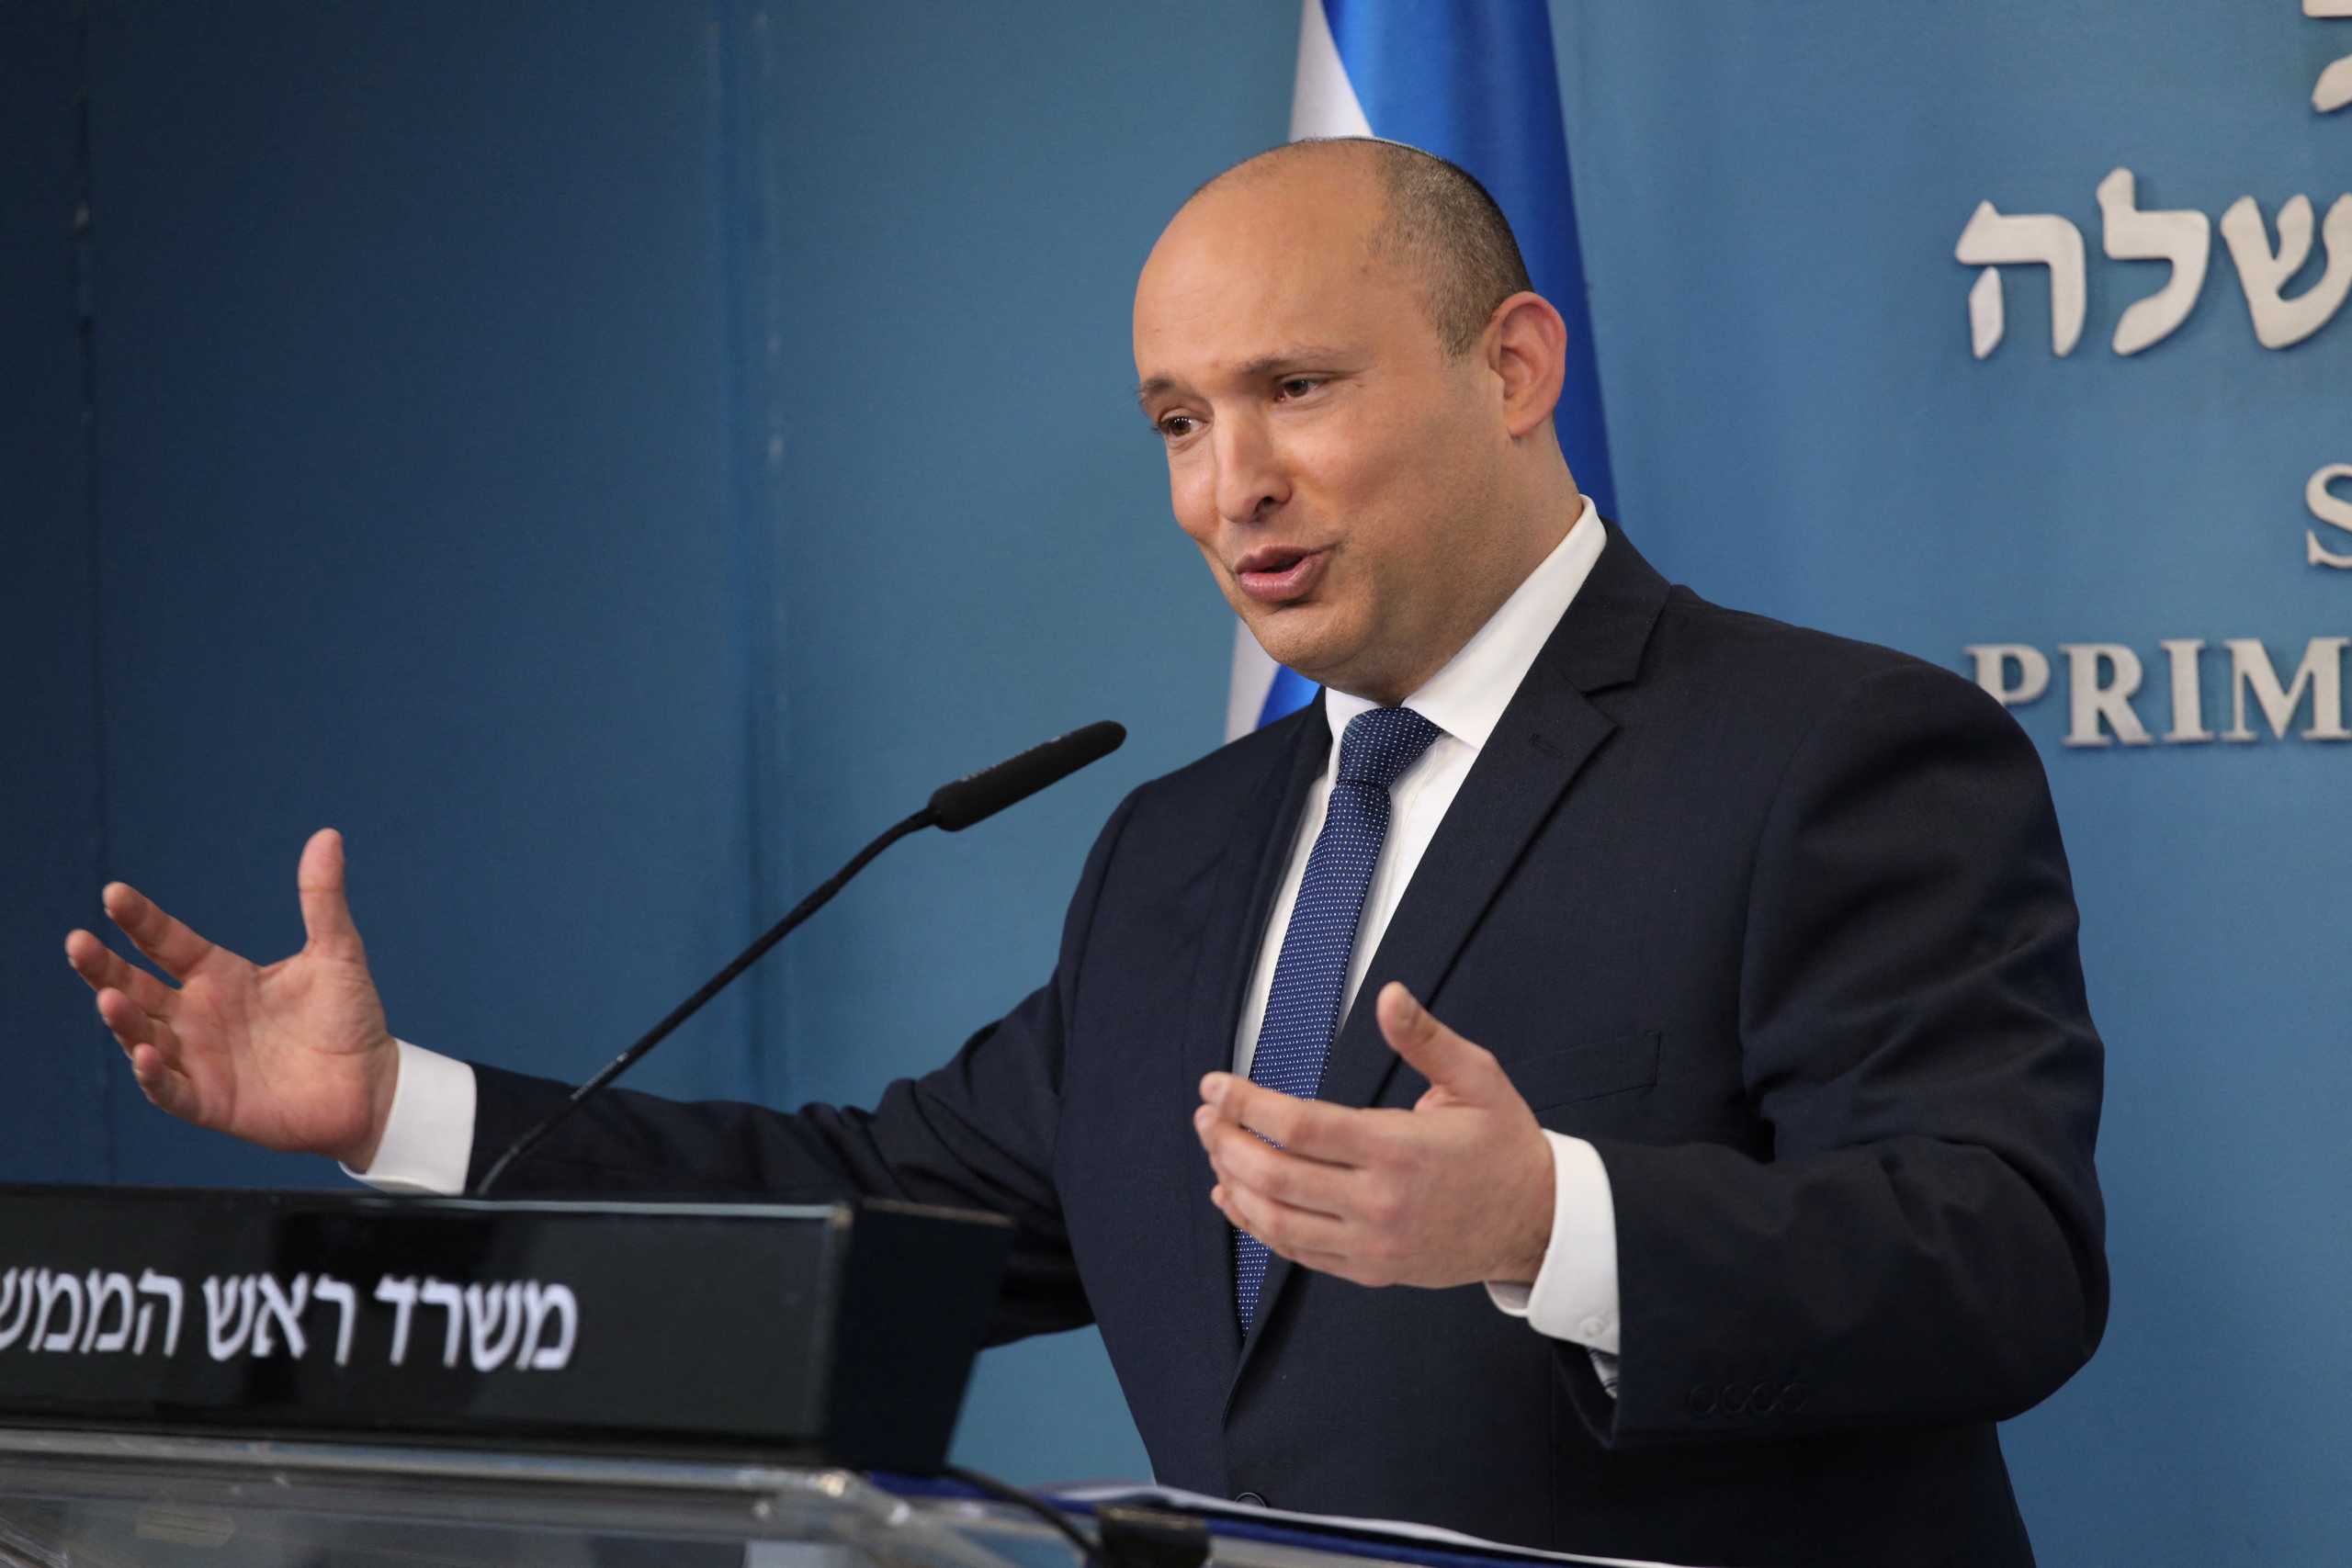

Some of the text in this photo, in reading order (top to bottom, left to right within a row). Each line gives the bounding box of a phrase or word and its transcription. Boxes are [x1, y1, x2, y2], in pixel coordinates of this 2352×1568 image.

[1955, 167, 2352, 359] שלה
[1963, 637, 2352, 748] PRIM
[202, 1272, 356, 1367] ראש
[374, 1275, 578, 1372] משרד
